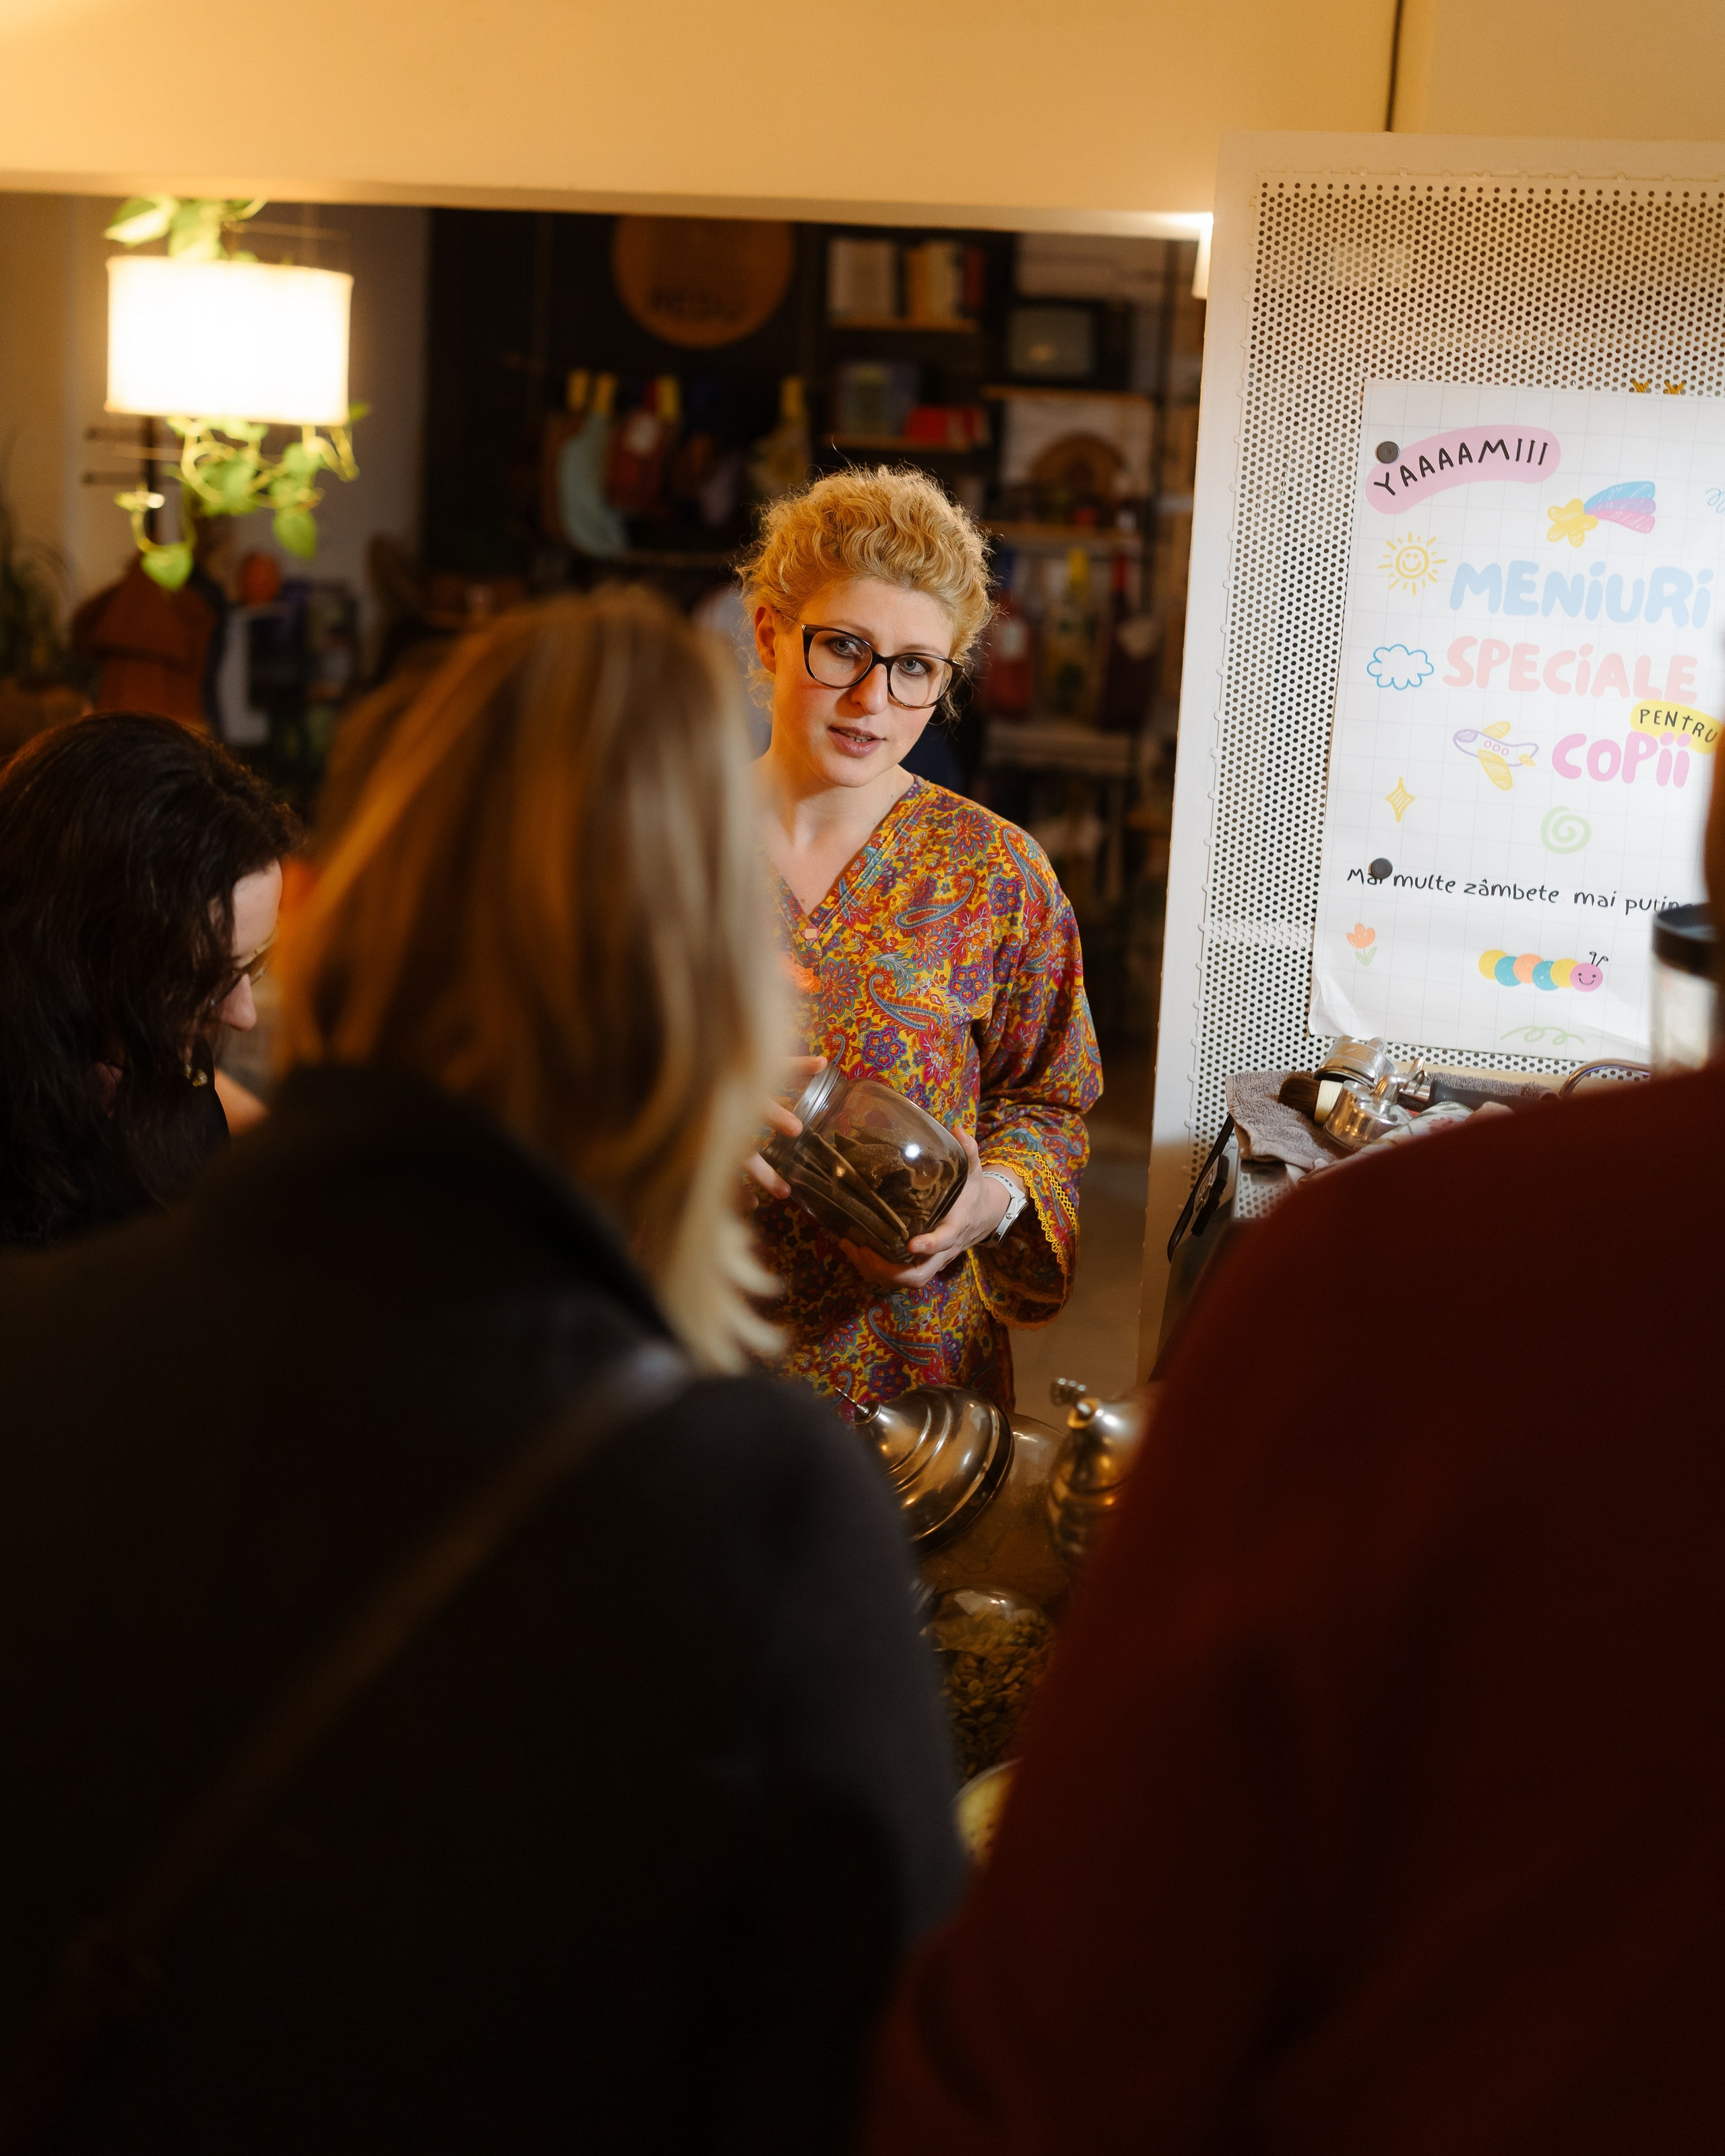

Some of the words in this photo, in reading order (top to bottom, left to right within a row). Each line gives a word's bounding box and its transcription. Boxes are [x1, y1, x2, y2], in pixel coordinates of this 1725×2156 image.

[1373, 438, 1548, 496] YAAAAMIII
[1639, 709, 1718, 743] PENTRU
[1393, 874, 1456, 893] multe
[1464, 879, 1560, 904] zâmbete
[1573, 891, 1617, 908] mai
